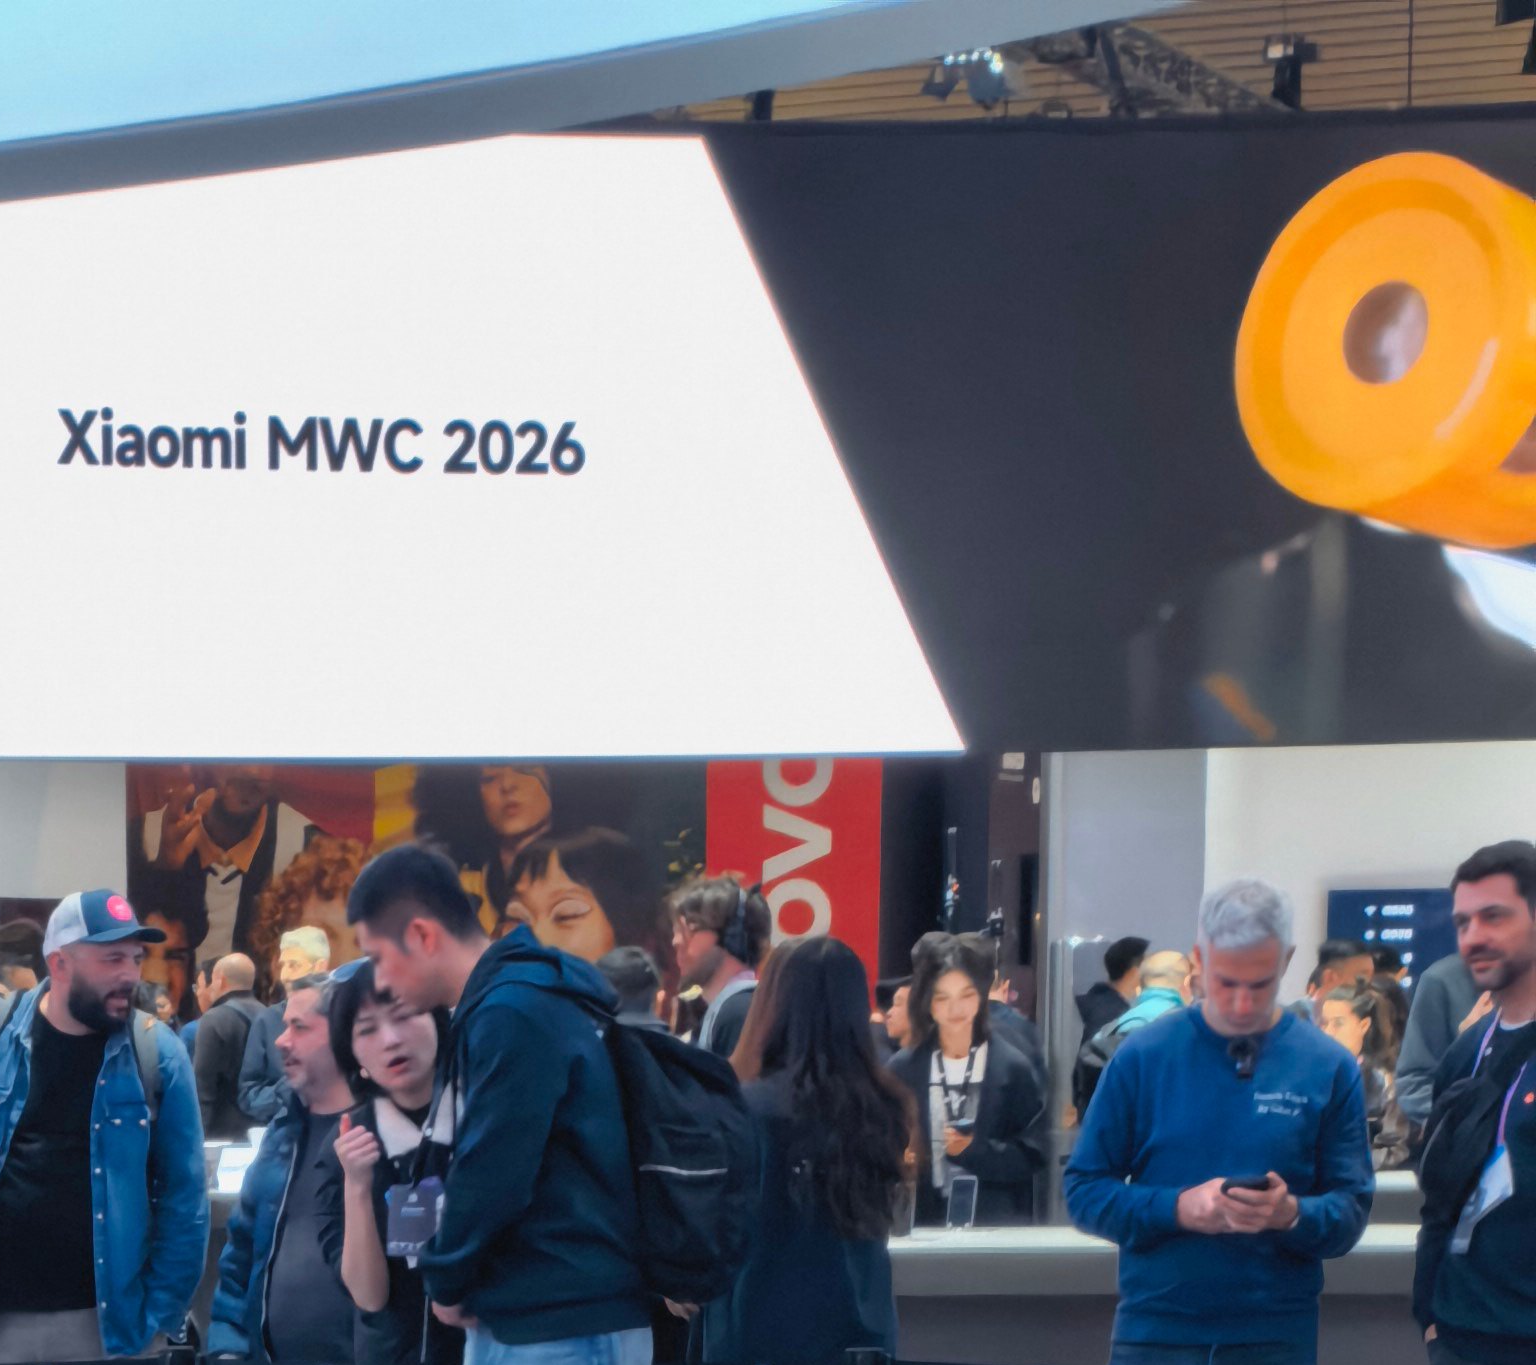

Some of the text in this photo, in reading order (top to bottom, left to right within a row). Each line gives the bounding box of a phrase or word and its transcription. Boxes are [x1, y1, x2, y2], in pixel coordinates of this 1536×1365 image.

[56, 406, 586, 476] Xiaomi MWC 2026
